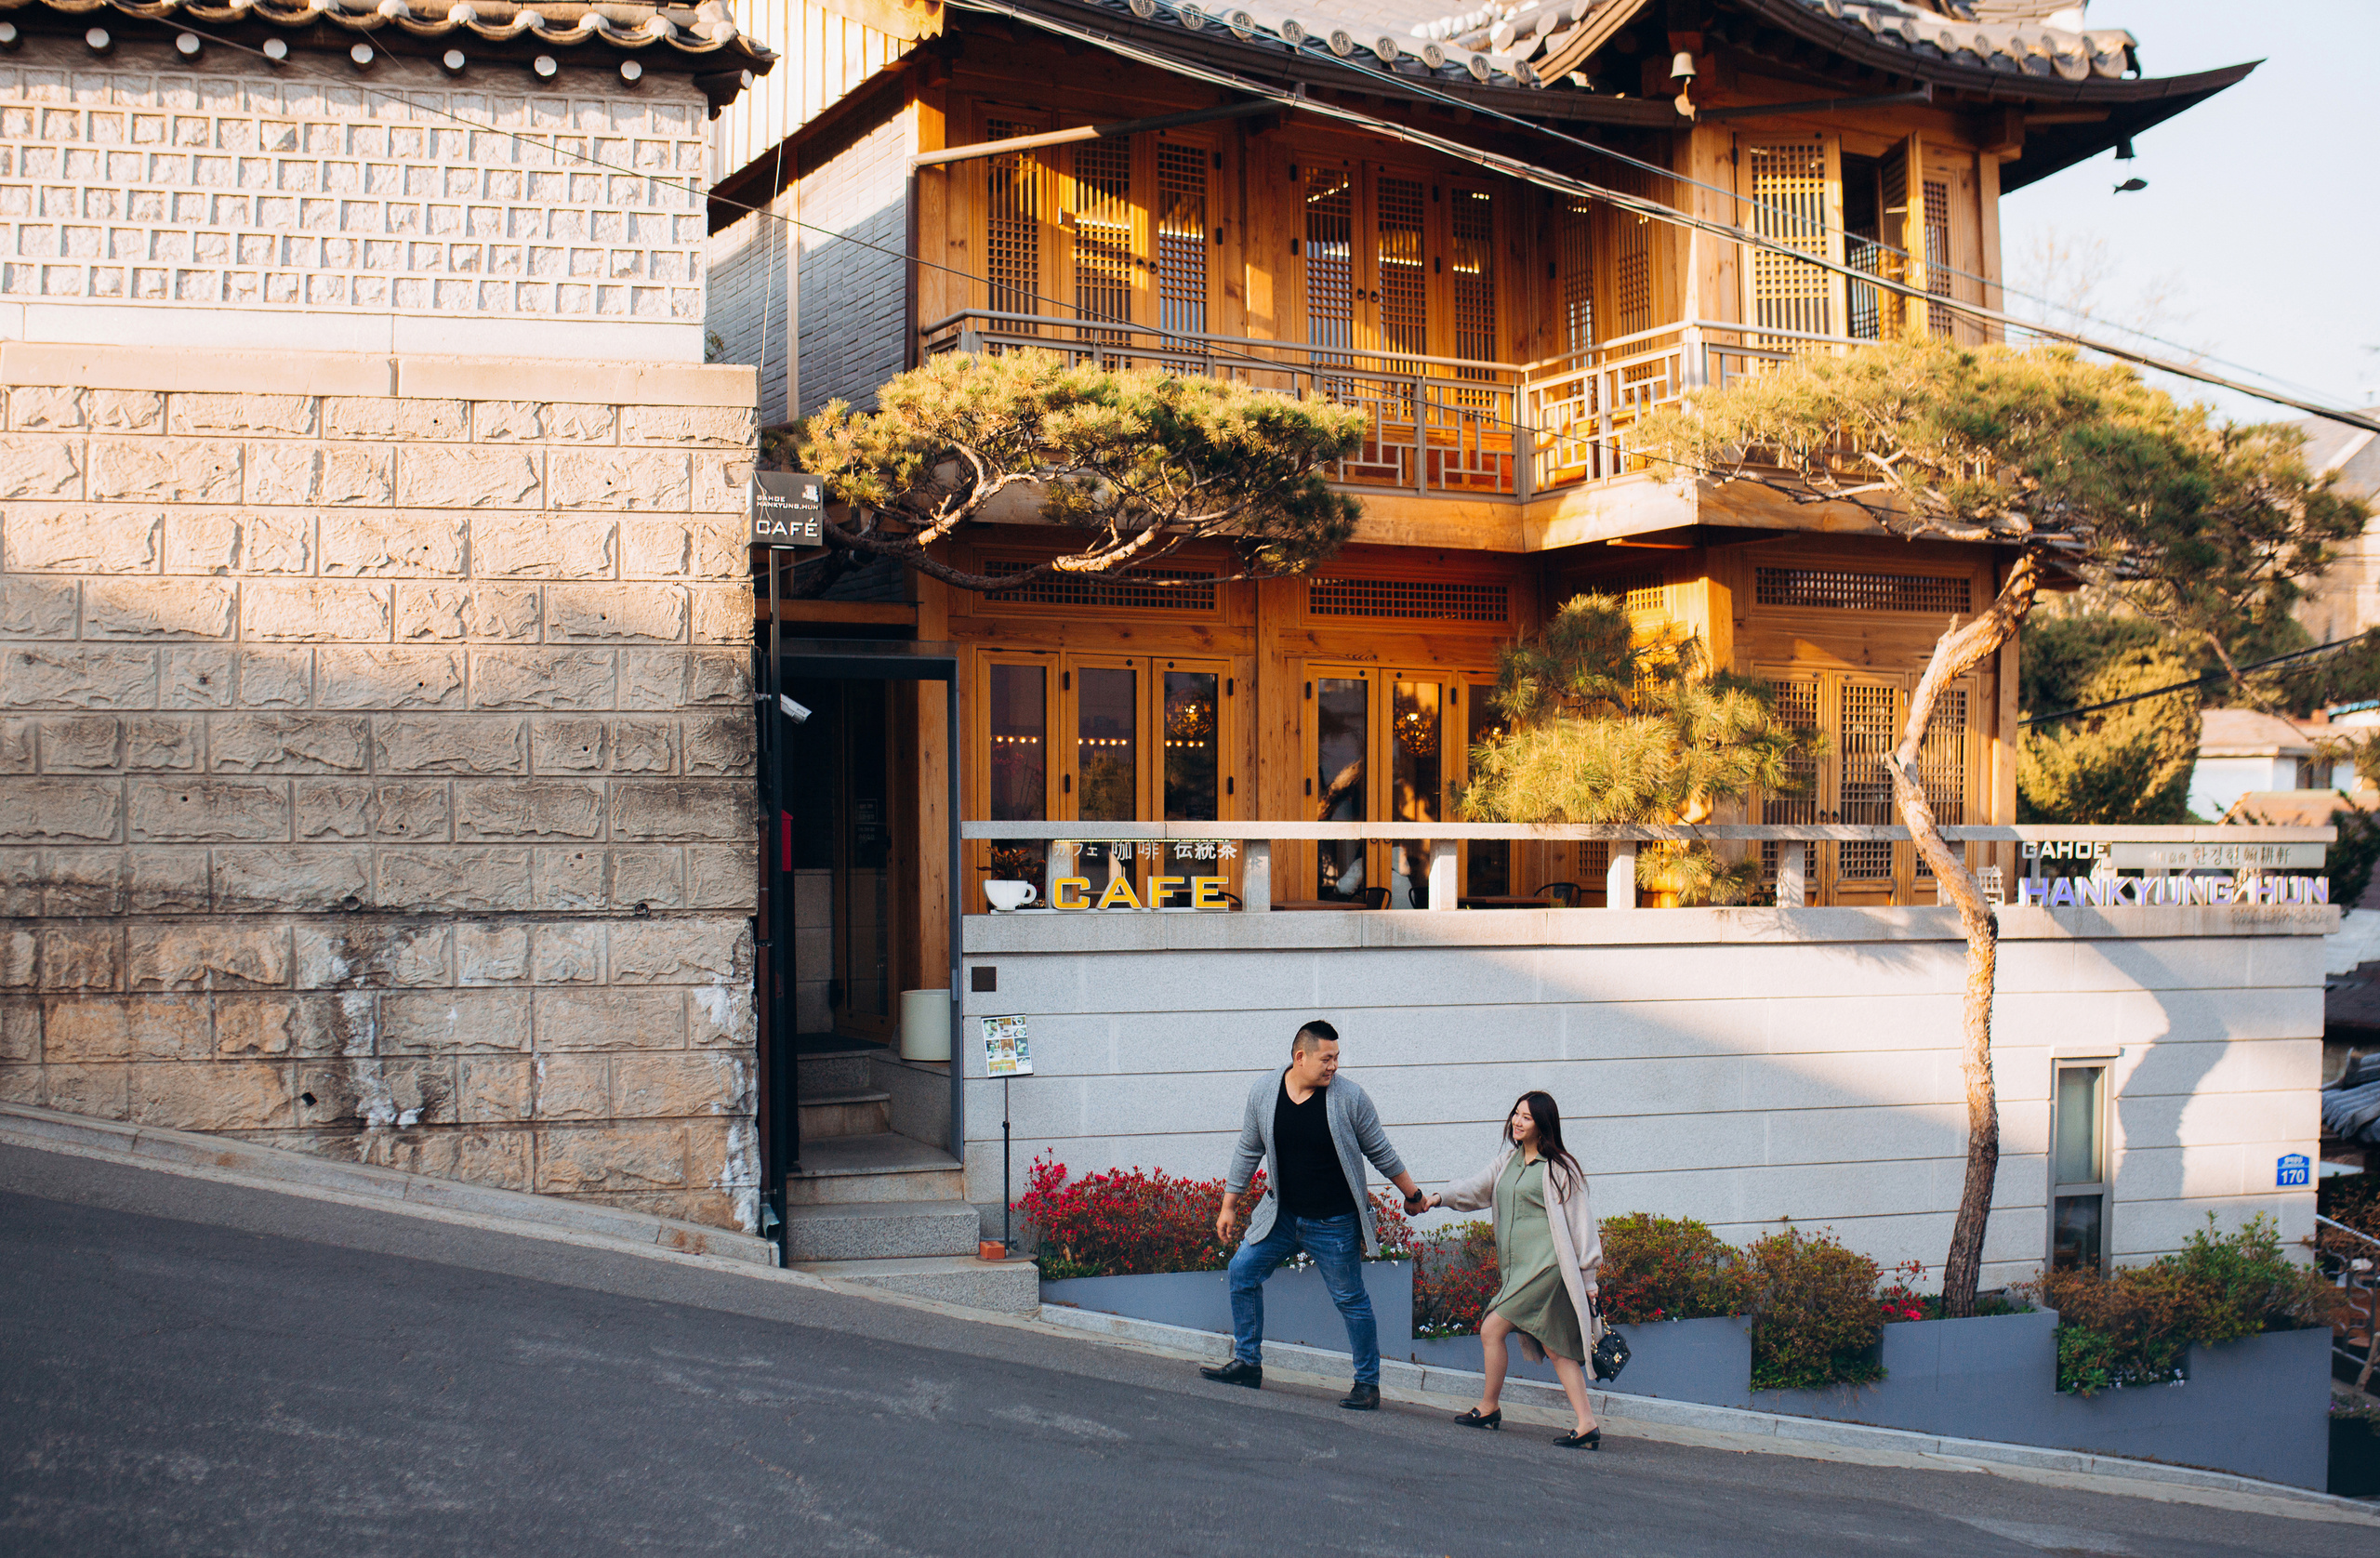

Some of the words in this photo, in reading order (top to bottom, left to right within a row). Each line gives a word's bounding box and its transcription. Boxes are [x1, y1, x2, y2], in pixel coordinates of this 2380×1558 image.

[756, 518, 818, 536] CAFÉ
[2021, 840, 2109, 860] GAHOE
[1051, 876, 1229, 910] CAFE
[2018, 876, 2235, 906] HANKYUNG
[2248, 876, 2330, 906] HUN
[2281, 1168, 2306, 1184] 170
